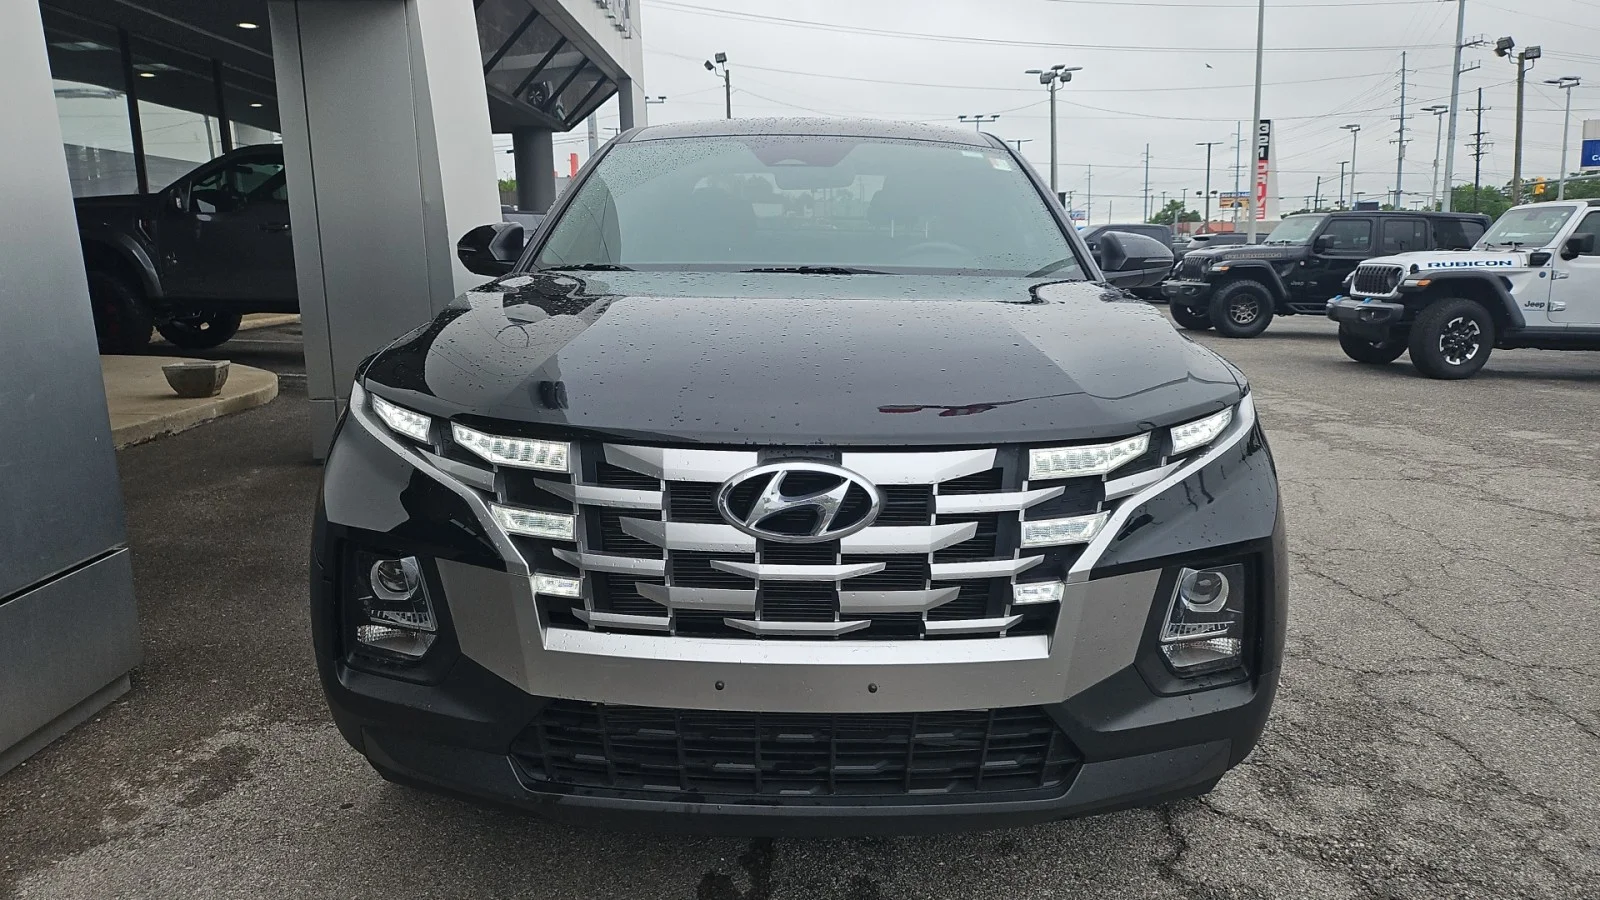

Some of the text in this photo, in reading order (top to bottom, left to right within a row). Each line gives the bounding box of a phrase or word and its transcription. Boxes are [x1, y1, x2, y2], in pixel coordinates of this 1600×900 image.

[1259, 122, 1270, 158] 321
[1428, 260, 1512, 268] RUBICON
[1525, 300, 1545, 308] Jeep
